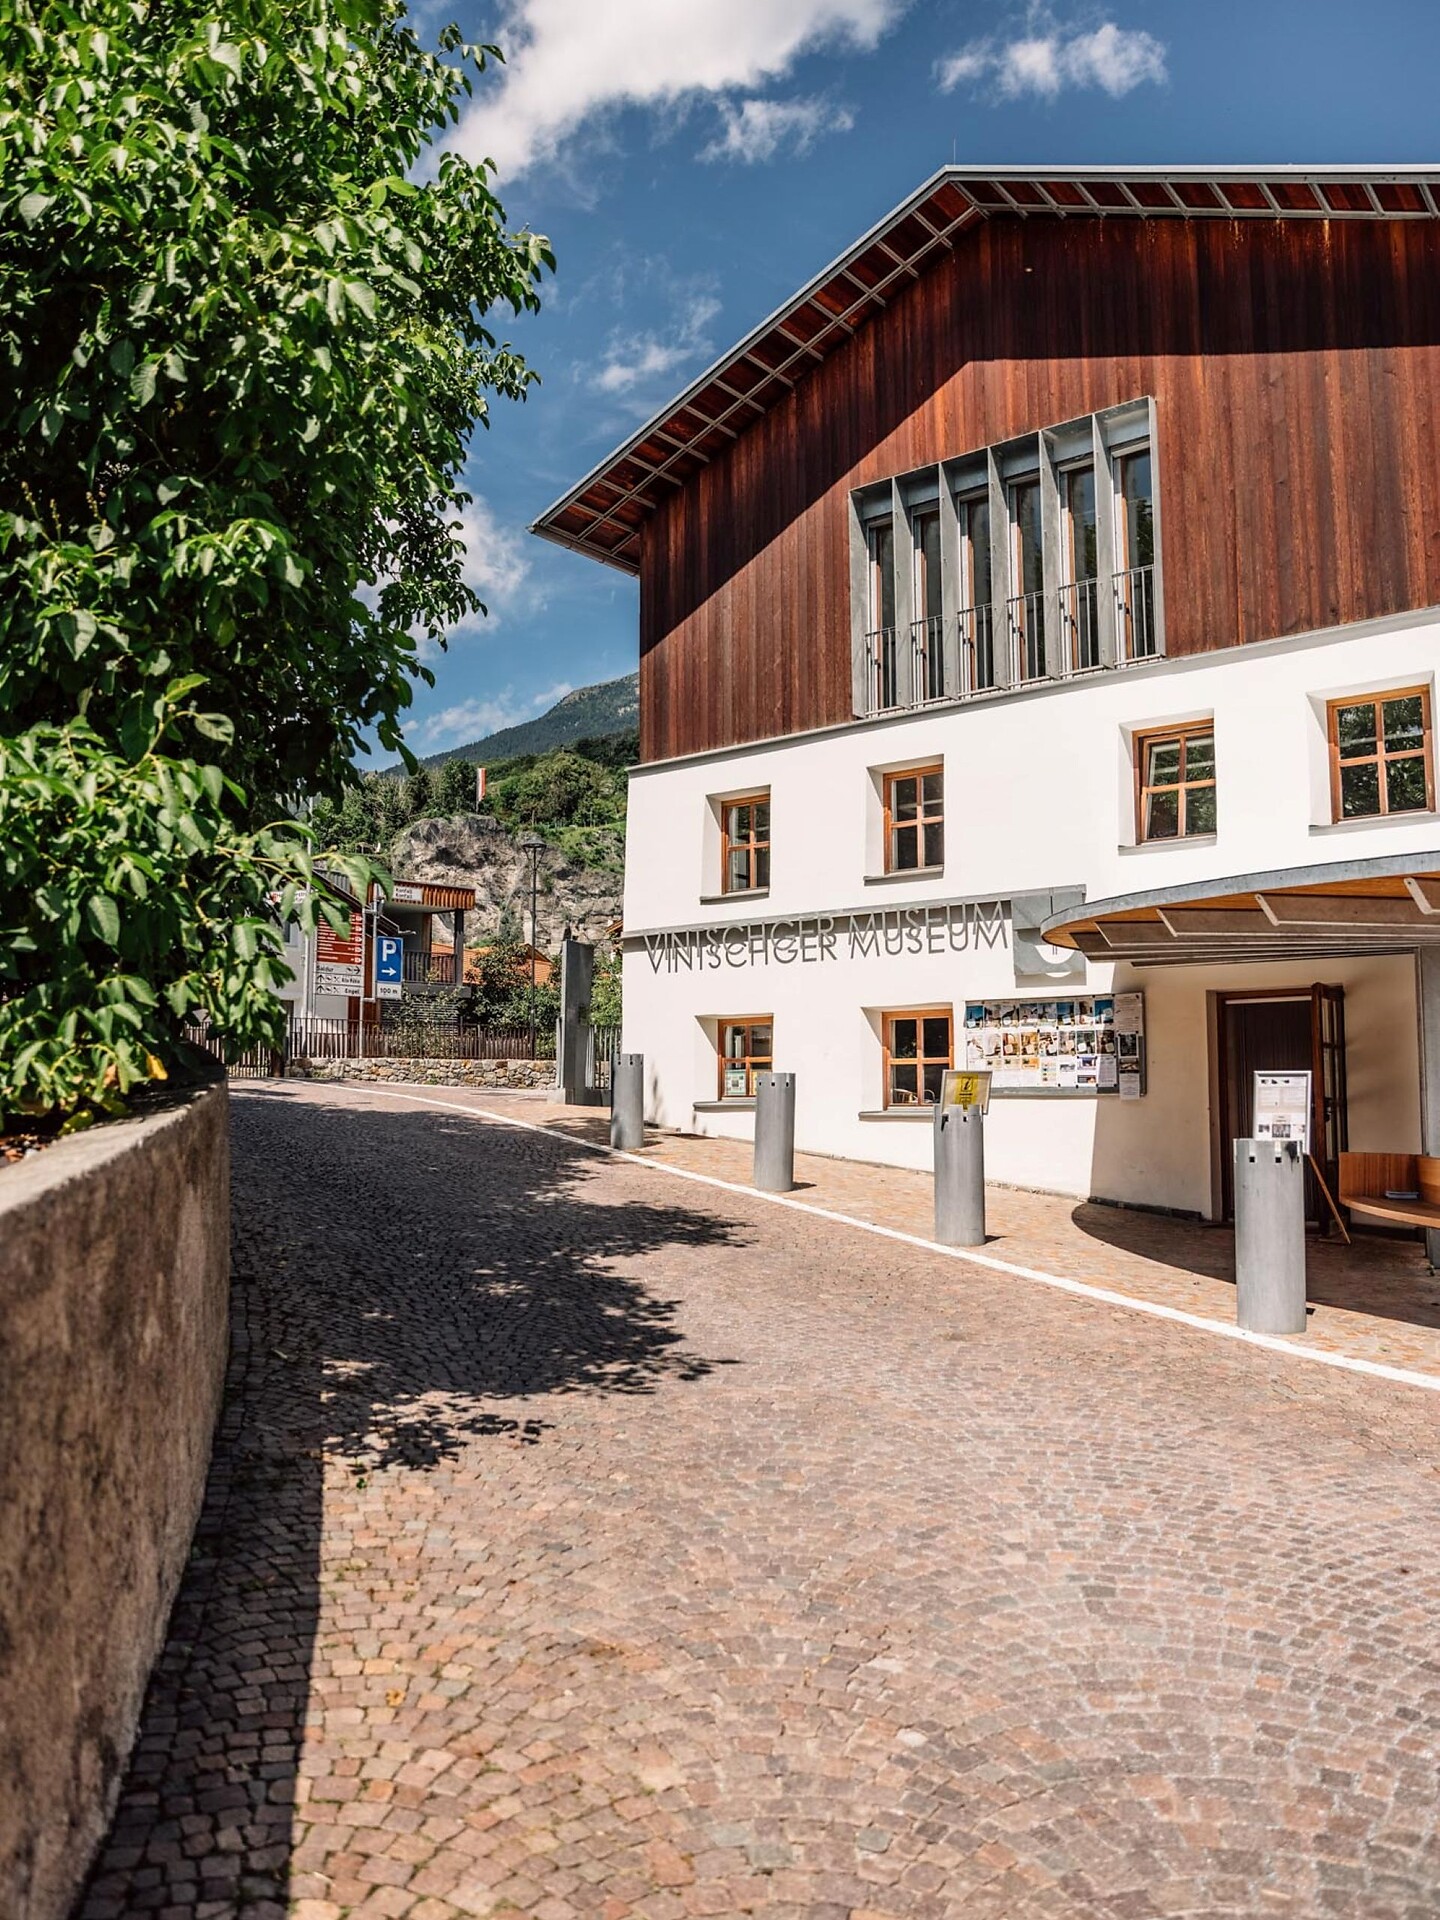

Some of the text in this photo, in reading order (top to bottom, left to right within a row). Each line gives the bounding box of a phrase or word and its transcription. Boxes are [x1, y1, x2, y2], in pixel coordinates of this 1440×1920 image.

[382, 939, 397, 962] P
[643, 899, 1006, 964] VINTSCHGER MUSEUM
